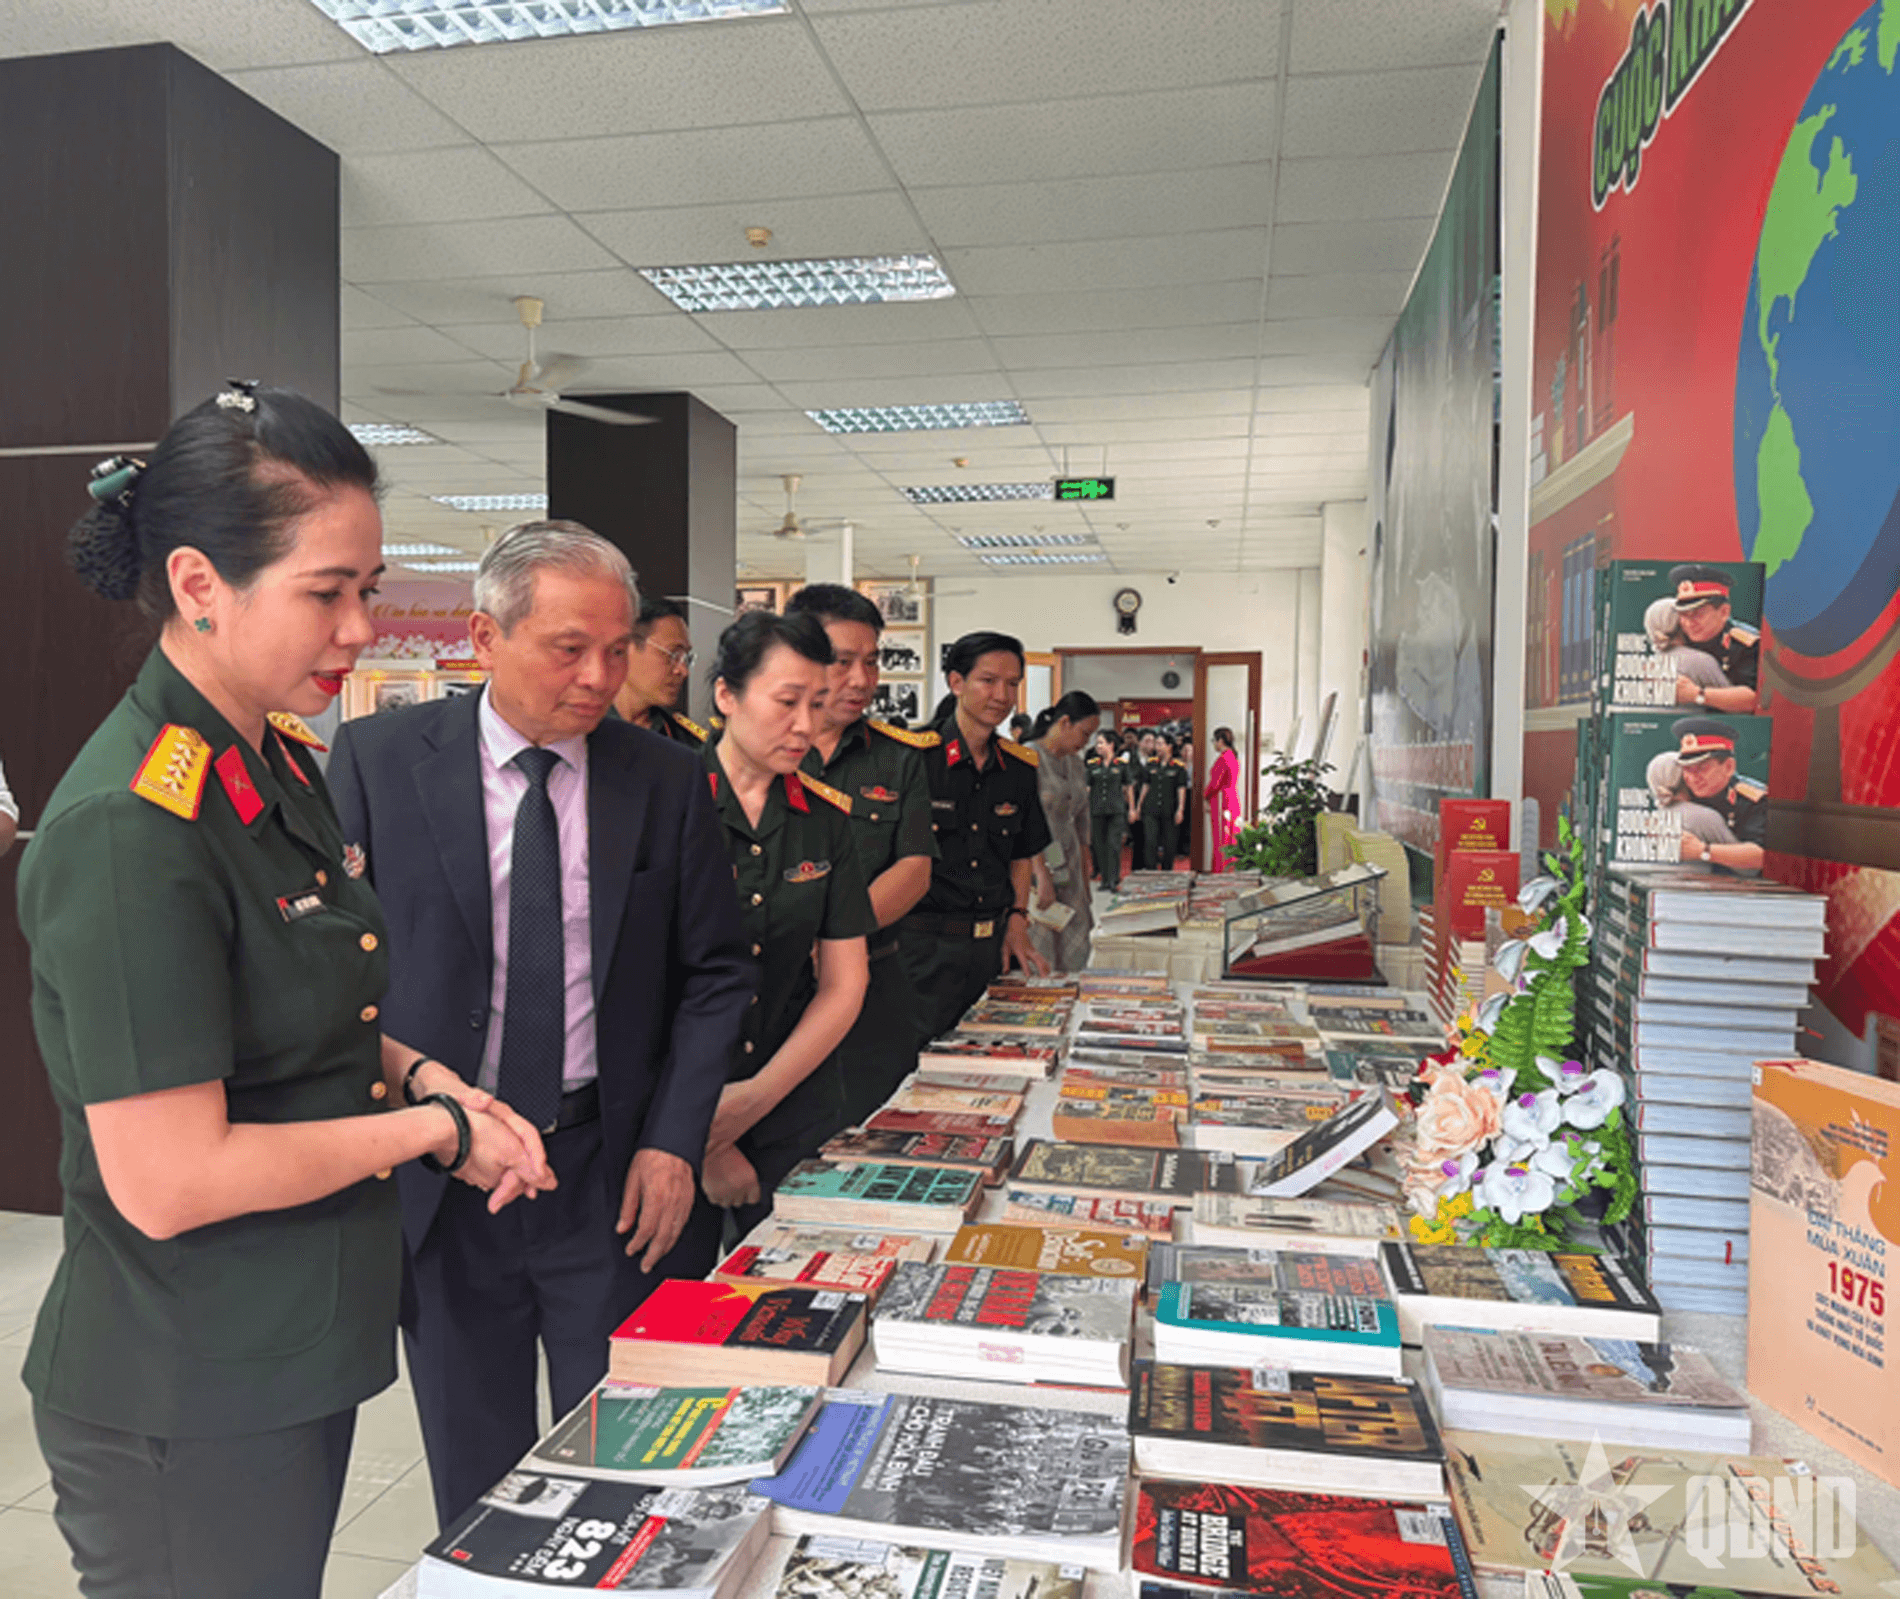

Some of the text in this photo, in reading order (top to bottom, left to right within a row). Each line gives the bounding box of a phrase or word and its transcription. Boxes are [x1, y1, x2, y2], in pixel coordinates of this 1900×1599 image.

[1593, 5, 1669, 208] CUỘC
[1827, 1260, 1885, 1317] 1975
[1843, 1245, 1886, 1279] XUÂN
[541, 1518, 618, 1581] 823
[1200, 1512, 1232, 1579] BRIDGE
